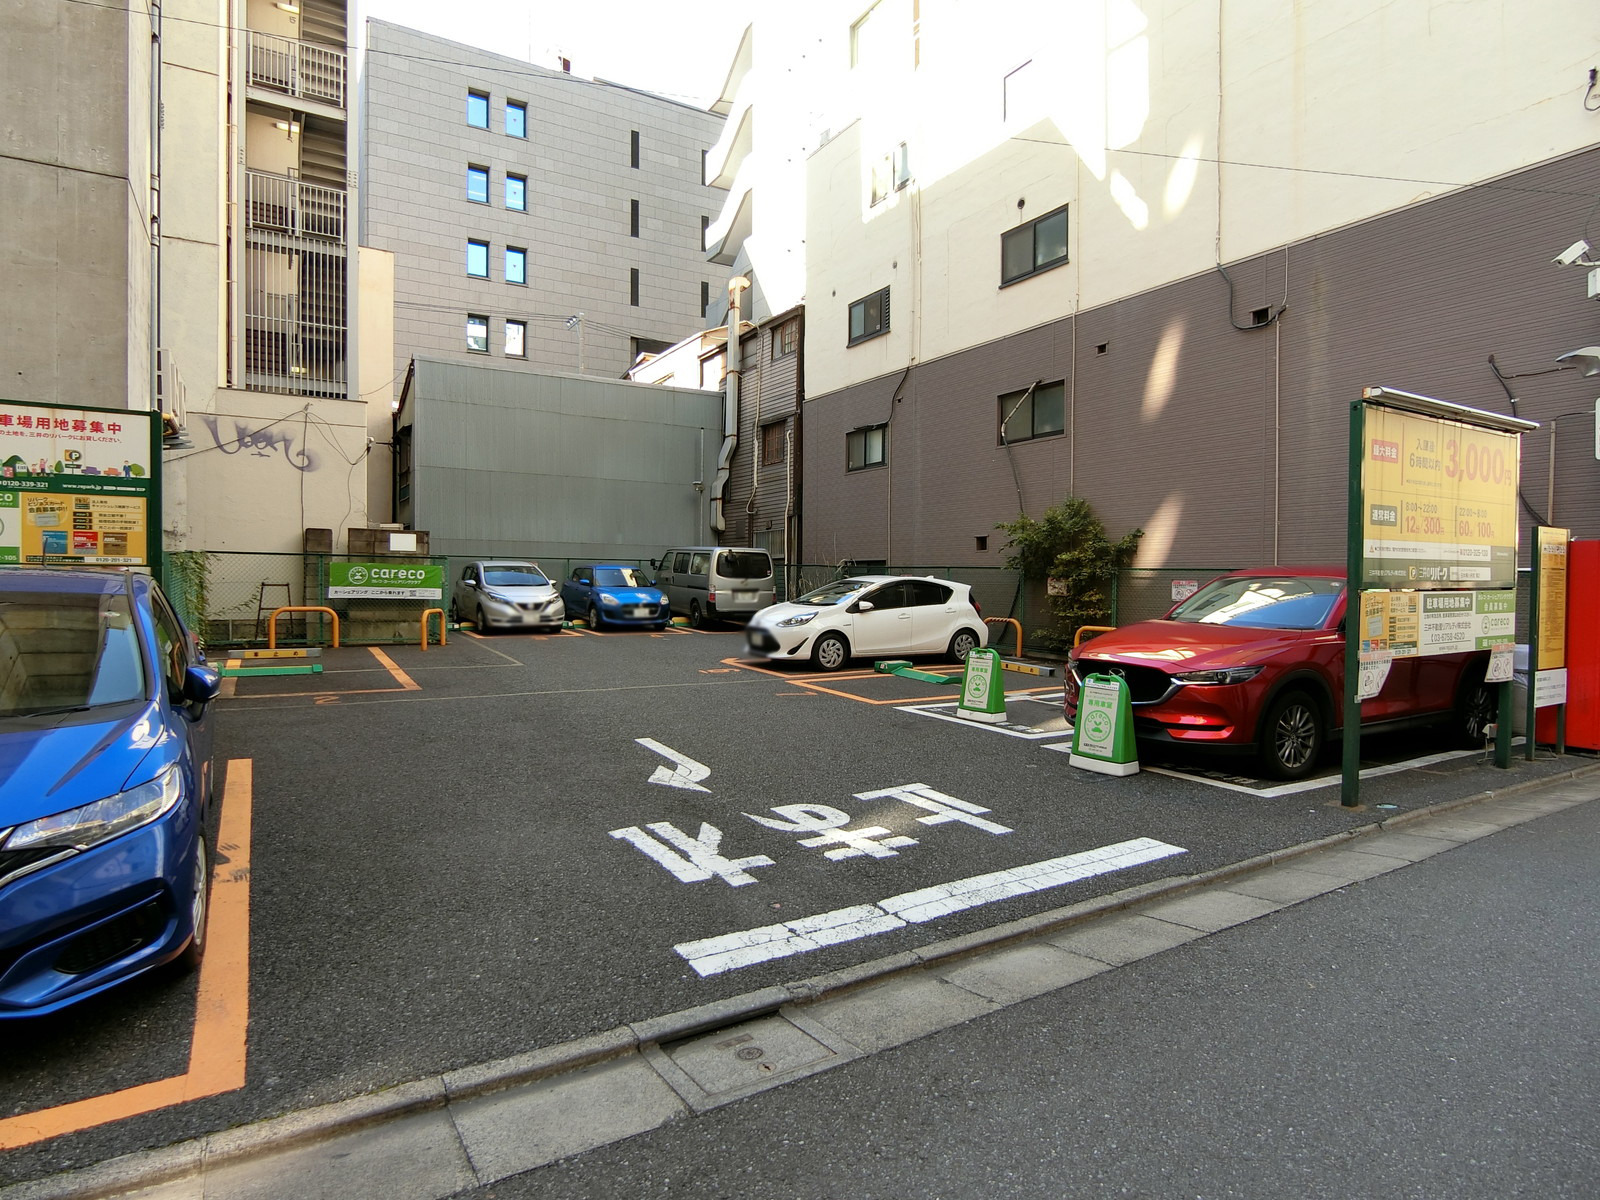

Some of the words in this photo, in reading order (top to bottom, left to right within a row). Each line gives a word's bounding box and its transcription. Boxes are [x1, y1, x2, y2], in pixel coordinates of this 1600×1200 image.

[0, 414, 122, 435] 車場用地募集中
[1373, 444, 1397, 459] 最大料金
[371, 568, 426, 579] careco
[1426, 597, 1470, 609] 駐車場用地募集中
[1087, 712, 1109, 726] careco
[608, 783, 1014, 887] 止まれ
